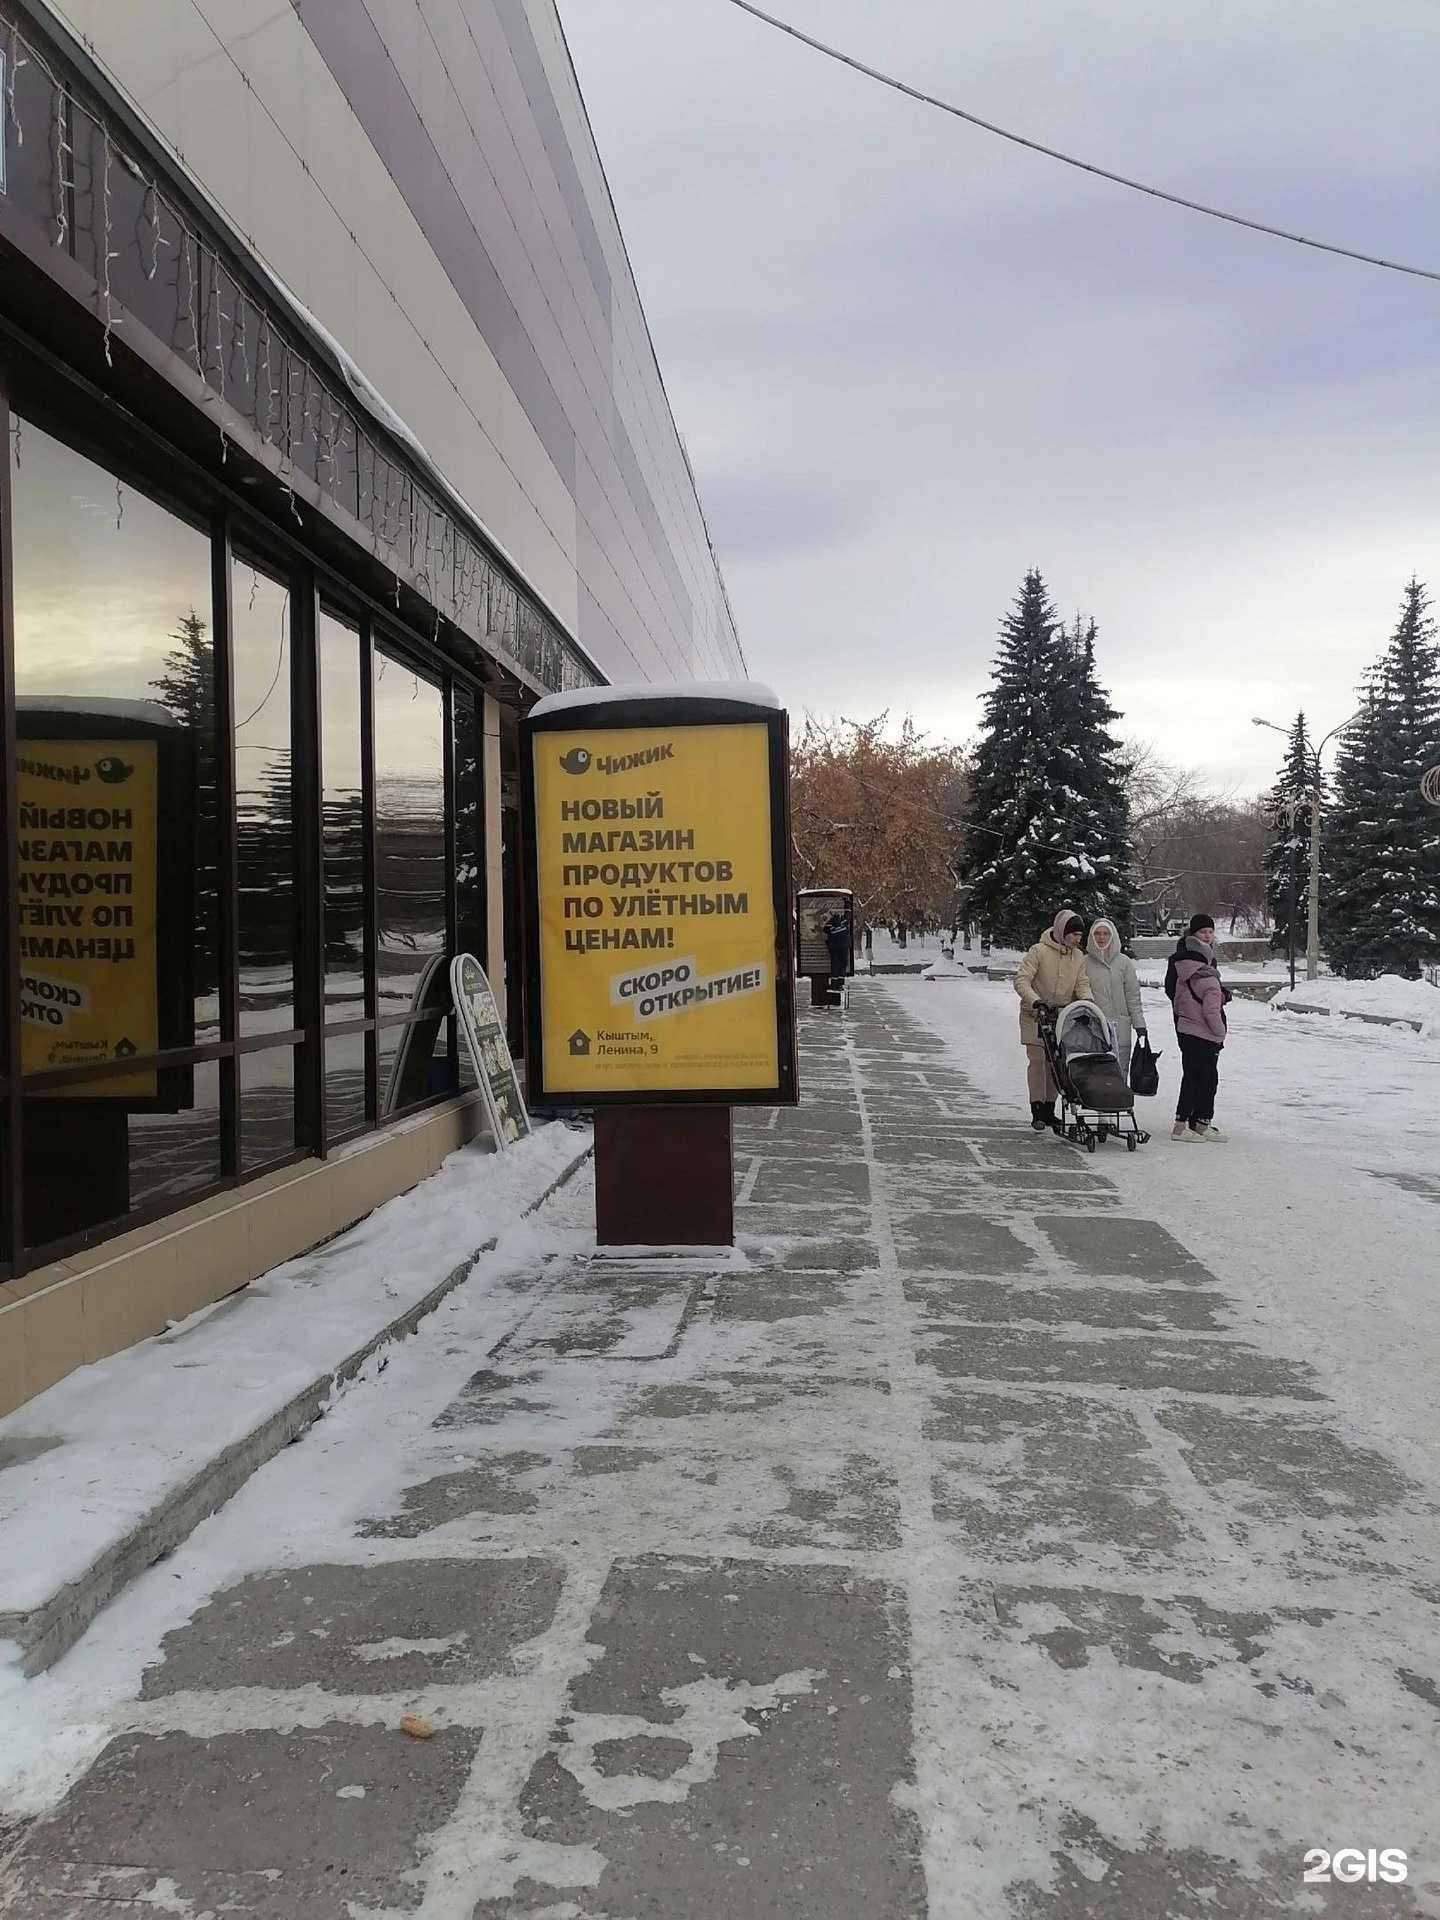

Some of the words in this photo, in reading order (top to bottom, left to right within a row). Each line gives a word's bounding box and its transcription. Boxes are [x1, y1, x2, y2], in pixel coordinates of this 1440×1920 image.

[597, 743, 674, 776] Чижик
[561, 791, 664, 821] НОВЫЙ
[562, 828, 694, 854] МАГАЗИН
[563, 861, 733, 888] ПРОДУКТОВ
[564, 895, 603, 919] ПО
[611, 889, 748, 917] УЛЁТНЫМ
[565, 927, 674, 955] ЦЕНАМ!
[618, 965, 690, 998] СКОРО
[638, 969, 762, 1016] ОТКРЫТИЕ!
[597, 1030, 653, 1042] Кыштым,
[597, 1045, 648, 1056] Ленина,
[650, 1045, 658, 1055] 9
